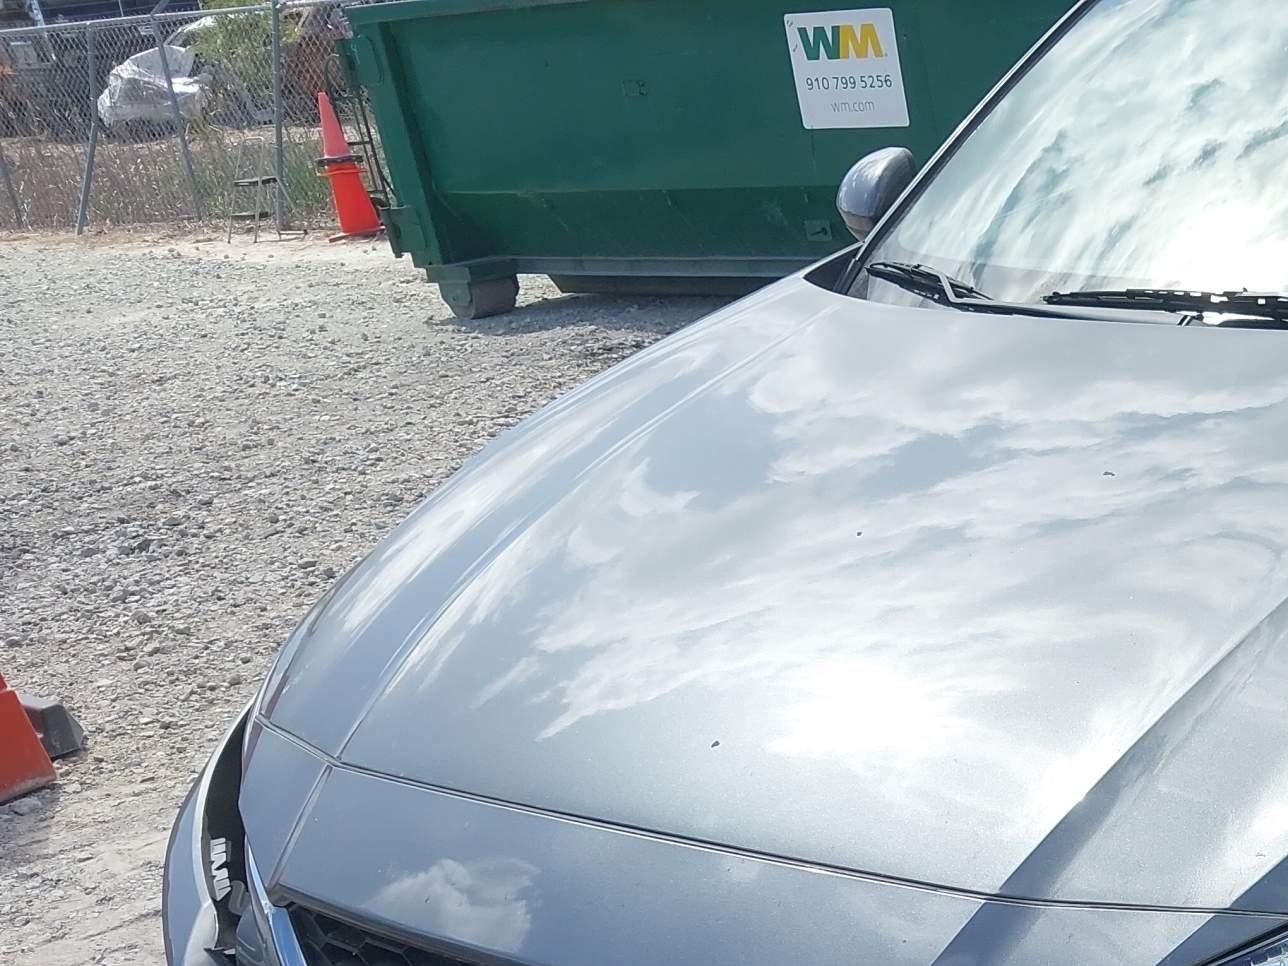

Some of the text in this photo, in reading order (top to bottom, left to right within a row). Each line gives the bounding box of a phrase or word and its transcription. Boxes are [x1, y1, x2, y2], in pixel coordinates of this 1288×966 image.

[797, 23, 885, 60] WM
[806, 74, 893, 90] 910 799 5256
[831, 100, 875, 112] wm.com
